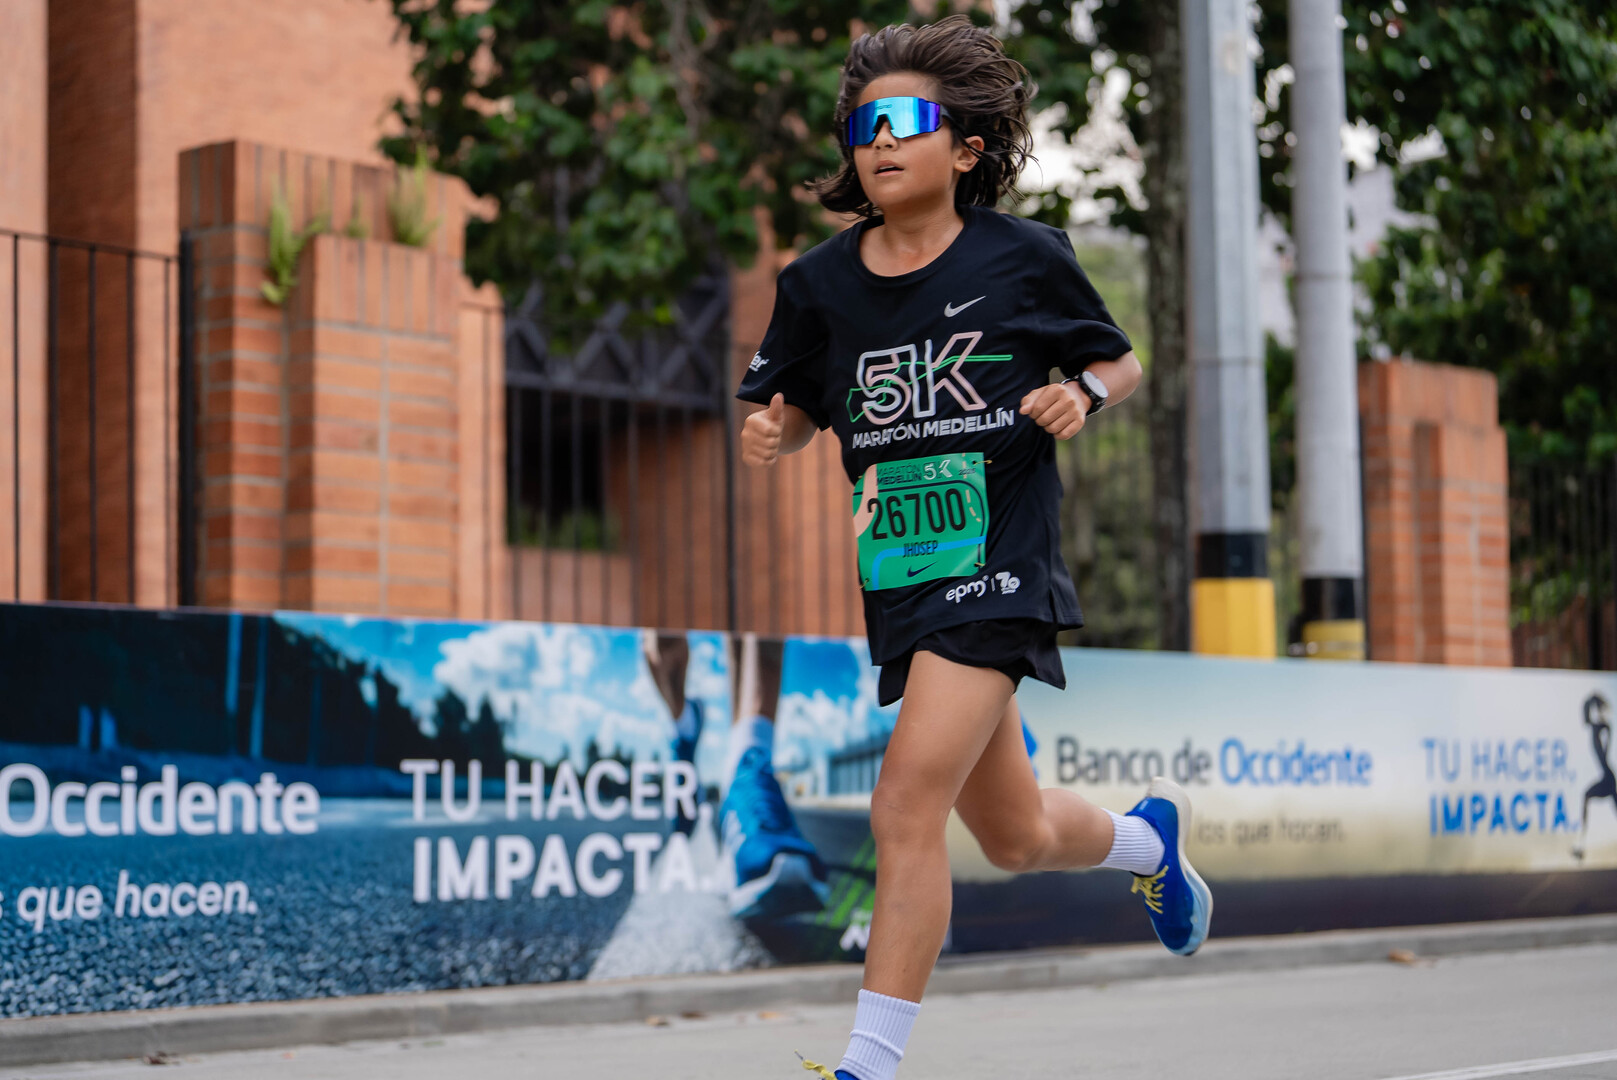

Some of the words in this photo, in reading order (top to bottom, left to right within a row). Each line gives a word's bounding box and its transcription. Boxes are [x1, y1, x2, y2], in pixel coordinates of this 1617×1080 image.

[856, 331, 988, 425] 5K
[852, 423, 920, 449] MARATÓN
[923, 407, 1015, 438] MEDELLÍN
[867, 488, 966, 540] 26700
[902, 540, 938, 558] JHOSEP
[1056, 736, 1164, 785] Banco
[1172, 737, 1212, 785] de
[1219, 737, 1373, 787] Occidente
[1422, 738, 1462, 782] TU
[1471, 738, 1577, 783] HACER,
[0, 763, 320, 837] Occidente
[400, 758, 482, 822] TU
[1429, 792, 1580, 838] IMPACTA.
[413, 832, 715, 902] IMPACTA.
[17, 883, 103, 933] que
[115, 869, 257, 918] hacen.
